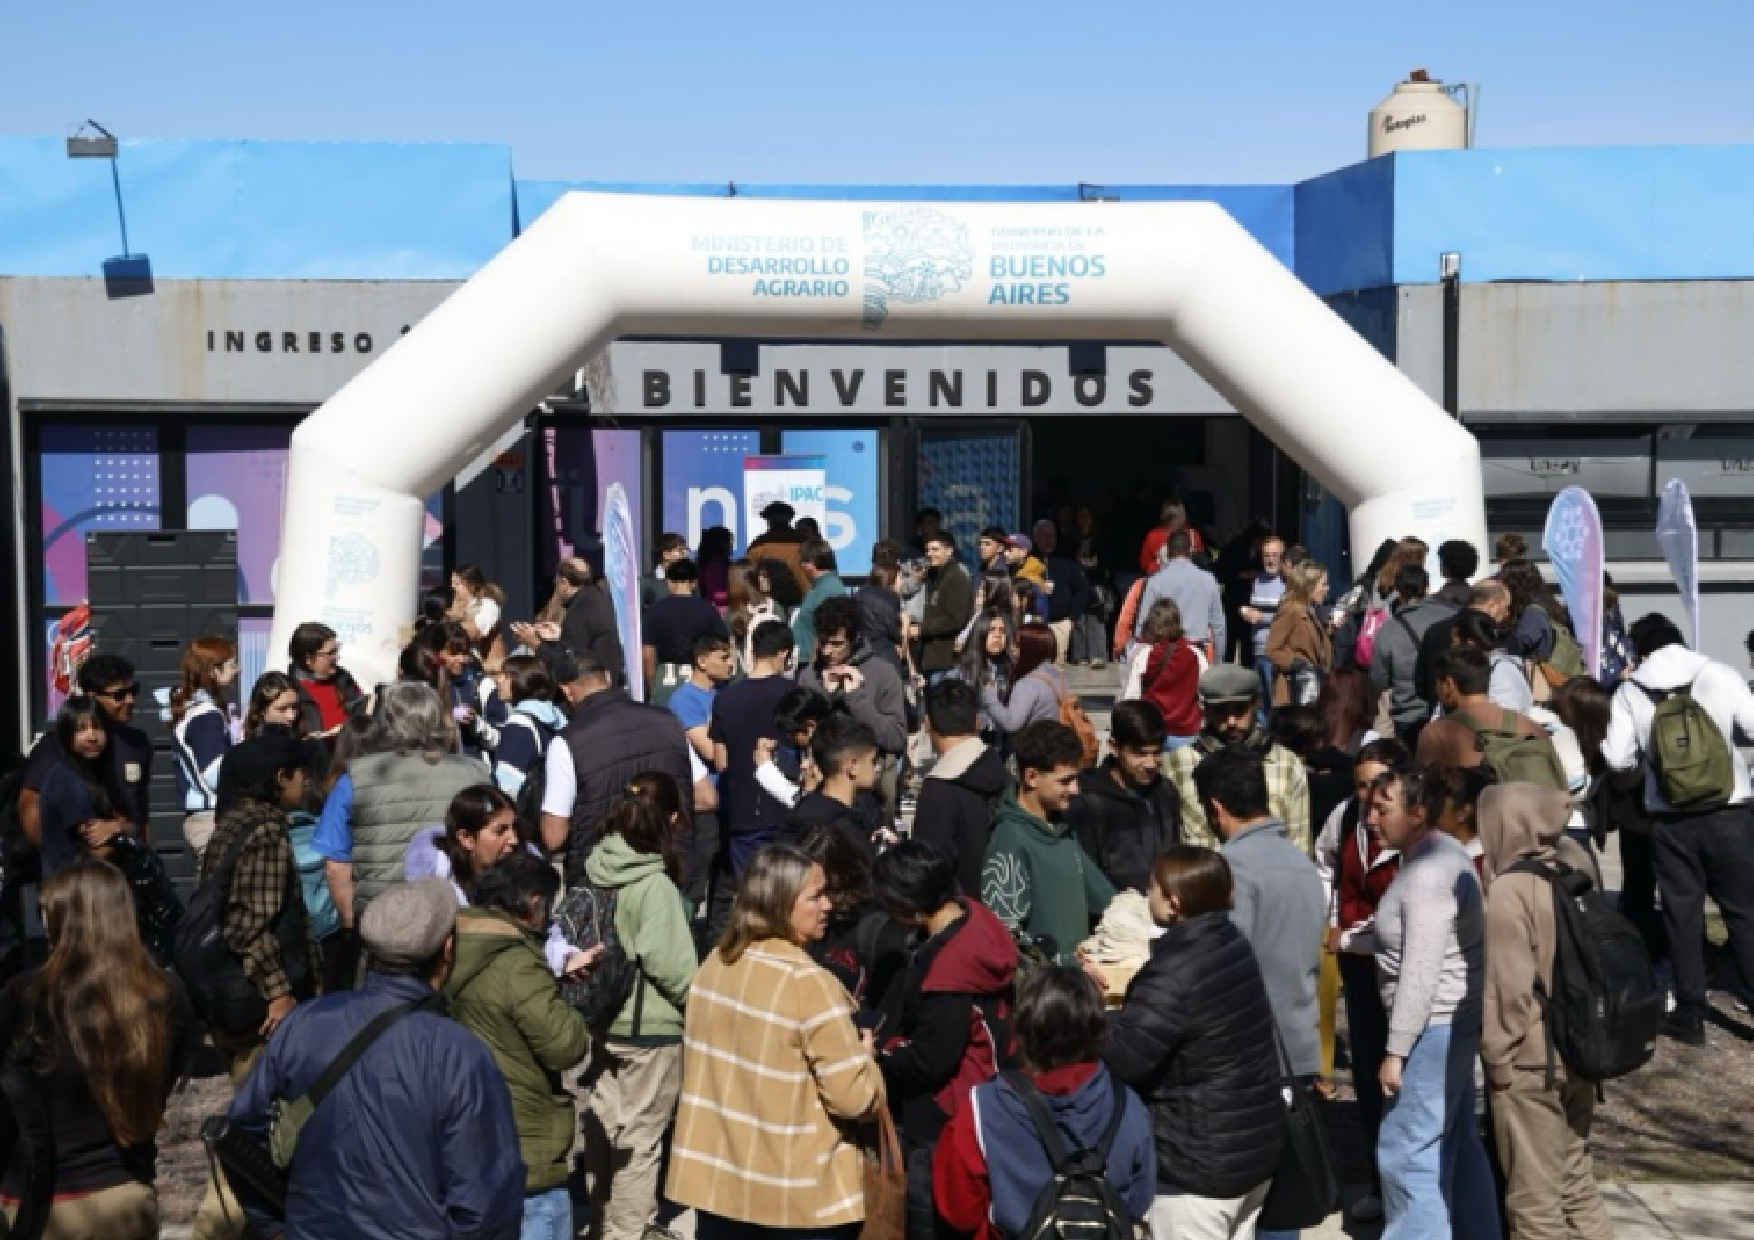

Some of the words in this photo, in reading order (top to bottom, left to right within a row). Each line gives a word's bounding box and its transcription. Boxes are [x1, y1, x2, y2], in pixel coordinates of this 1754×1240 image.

[690, 235, 815, 252] MINISTERIO
[821, 236, 850, 253] DE
[707, 256, 850, 275] DESARROLLO
[989, 255, 1107, 279] BUENOS
[752, 278, 850, 297] AGRARIO
[987, 282, 1071, 304] AIRES
[206, 329, 374, 354] INGRESO
[642, 368, 1155, 407] BIENVENIDOS
